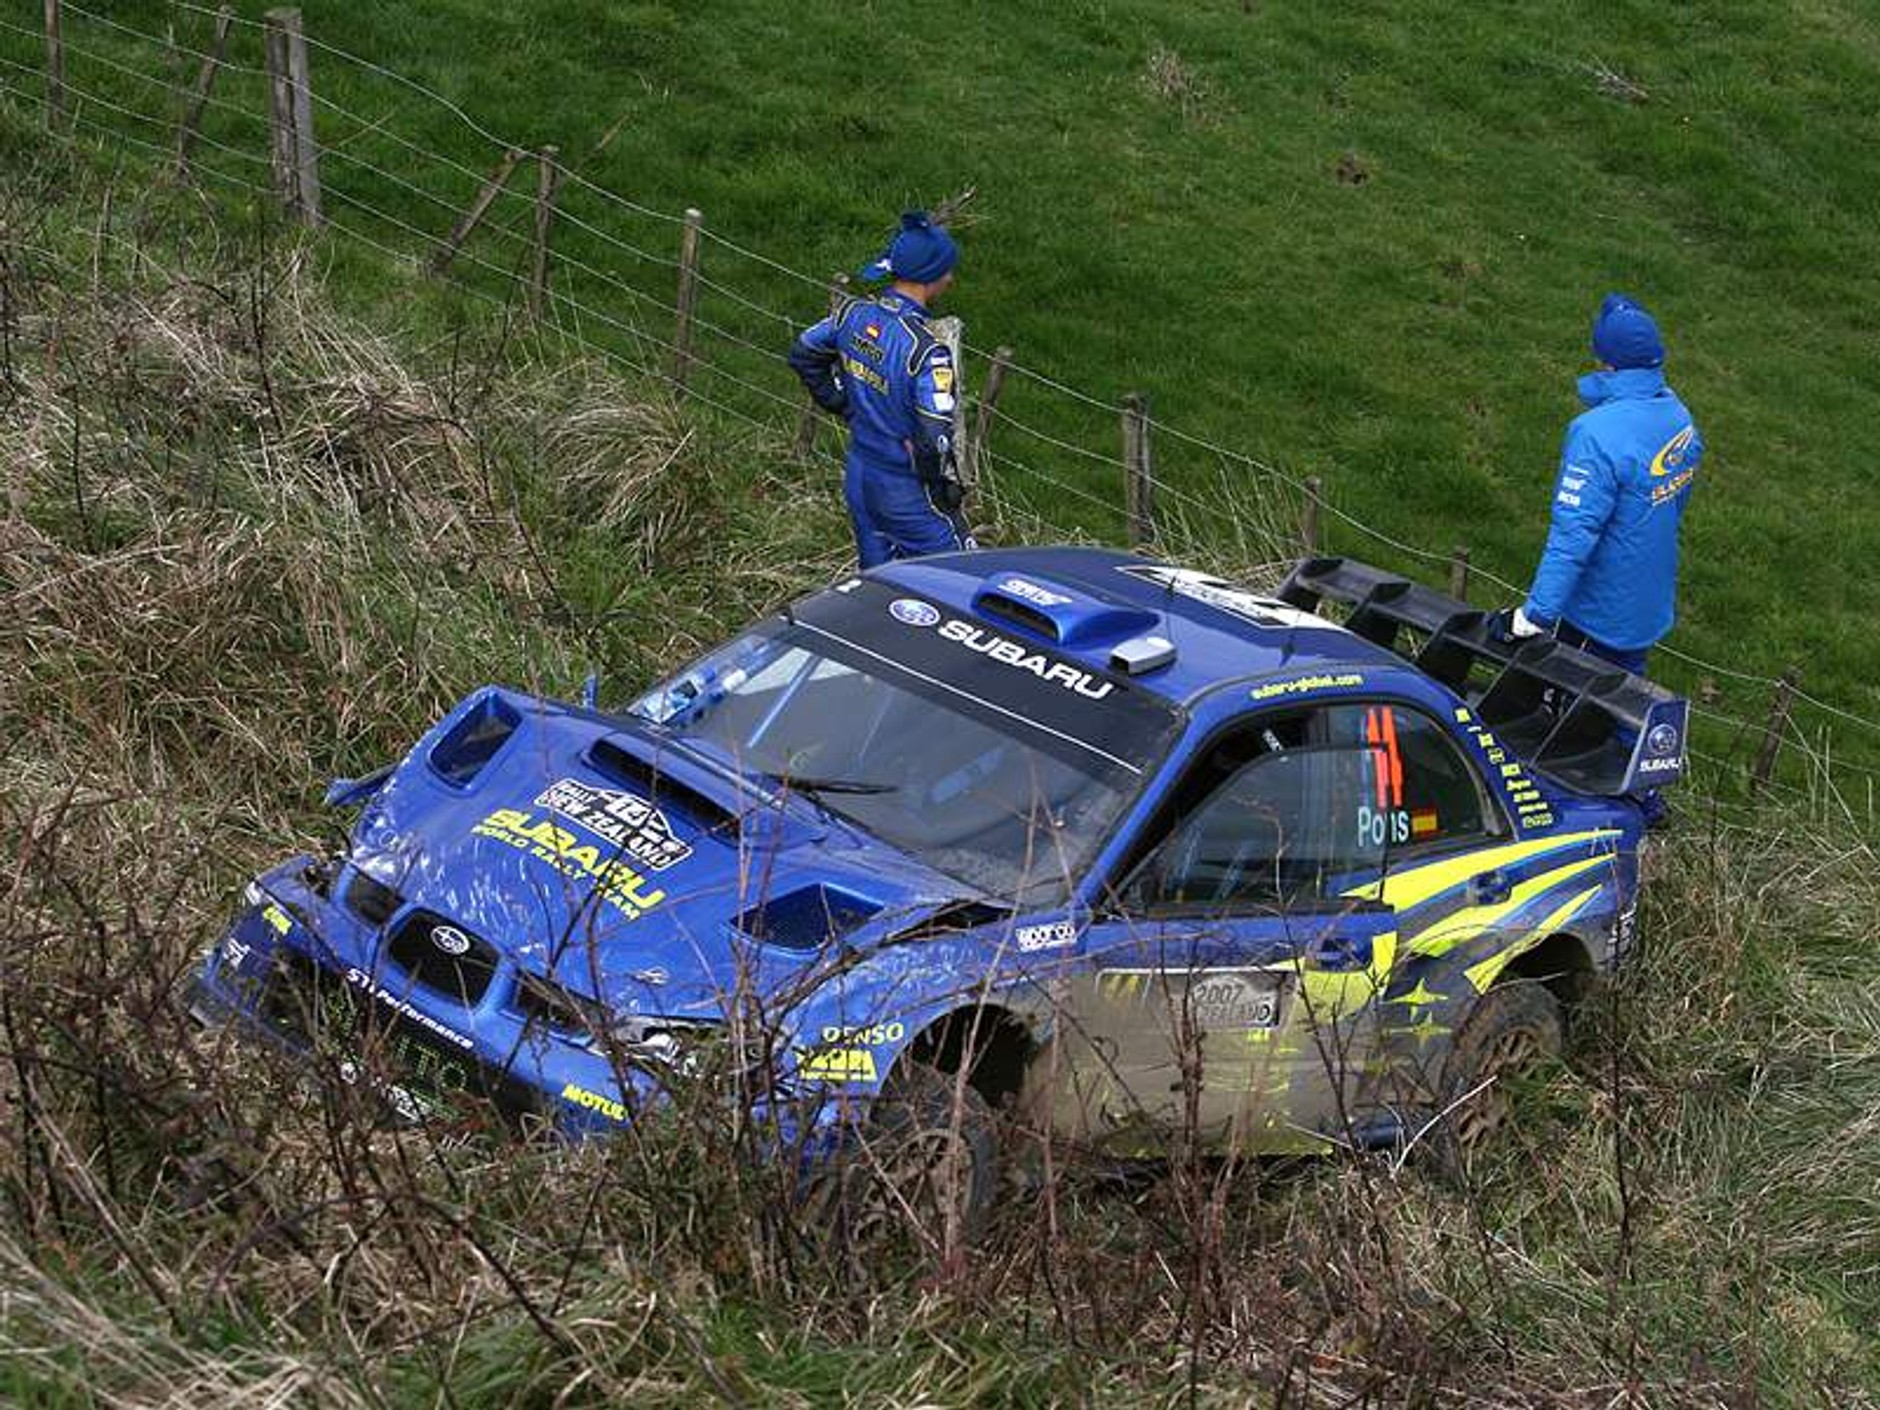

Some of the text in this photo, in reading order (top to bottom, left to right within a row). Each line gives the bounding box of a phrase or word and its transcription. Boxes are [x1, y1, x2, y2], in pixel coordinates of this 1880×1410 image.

[938, 619, 1114, 699] SUBARU
[482, 808, 667, 909] SUBARU
[583, 811, 670, 866] ZEALAND
[376, 990, 474, 1050] Performance
[1195, 983, 1245, 1004] 2007
[822, 1022, 904, 1046] DENSO
[562, 1083, 625, 1121] MOTUL
